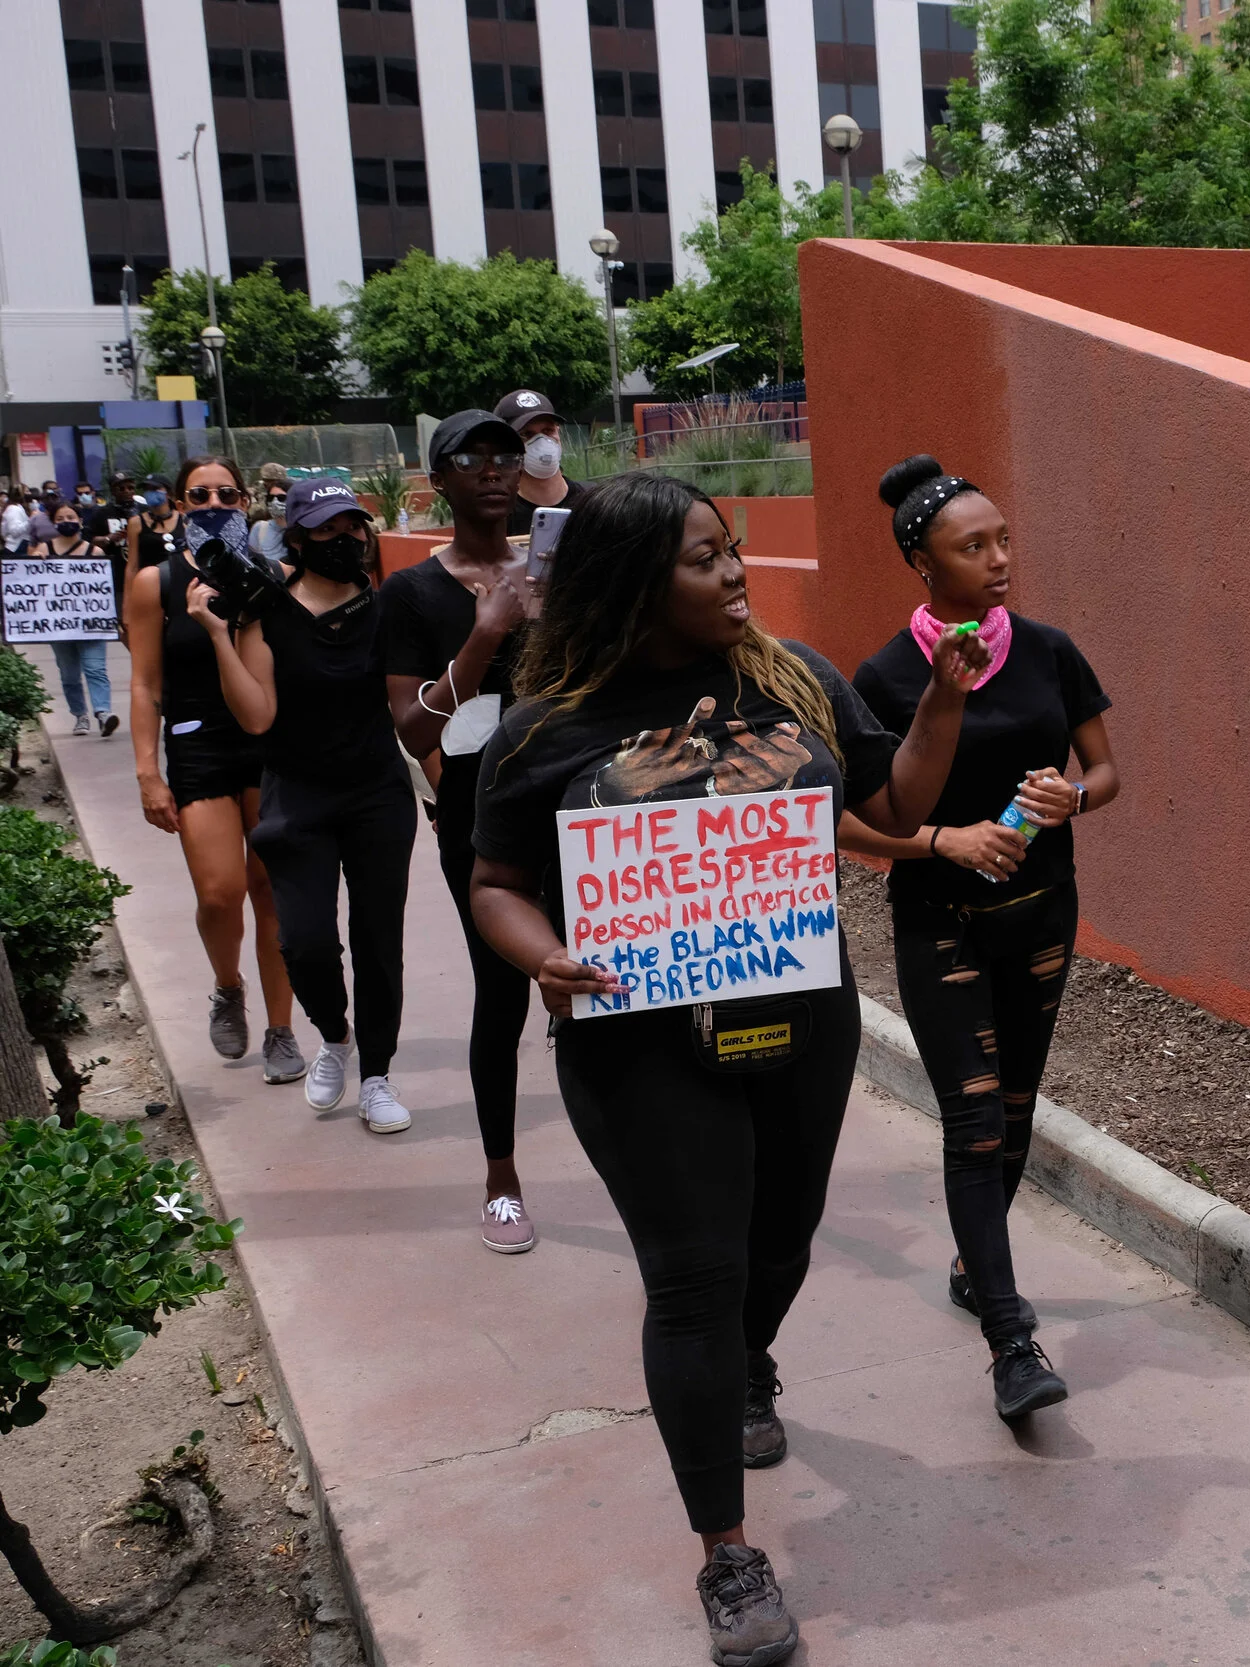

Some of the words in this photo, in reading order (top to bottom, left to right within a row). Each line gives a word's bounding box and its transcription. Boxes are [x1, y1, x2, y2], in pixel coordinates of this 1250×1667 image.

[1, 563, 18, 575] IF
[25, 562, 64, 575] YOU'RE
[68, 562, 108, 575] ANGRY
[4, 584, 49, 597] ABOUT
[53, 581, 112, 597] LOOTING
[5, 599, 39, 614] WAIT
[46, 599, 81, 612] UNTIL
[82, 599, 110, 613] YOU
[344, 596, 371, 616] Canon
[8, 619, 51, 635] HEAR
[53, 617, 80, 631] ABOUT
[567, 809, 680, 864] THE
[697, 794, 829, 848] MOST
[682, 894, 713, 927] IN
[608, 942, 660, 974] the
[670, 917, 765, 963] BLACK
[769, 903, 836, 942] WMN
[646, 944, 807, 1005] BREONNA
[720, 1035, 755, 1047] GIRLS
[757, 1029, 788, 1042] TOUR
[718, 1055, 730, 1063] S/S
[731, 1053, 747, 1061] 2019
